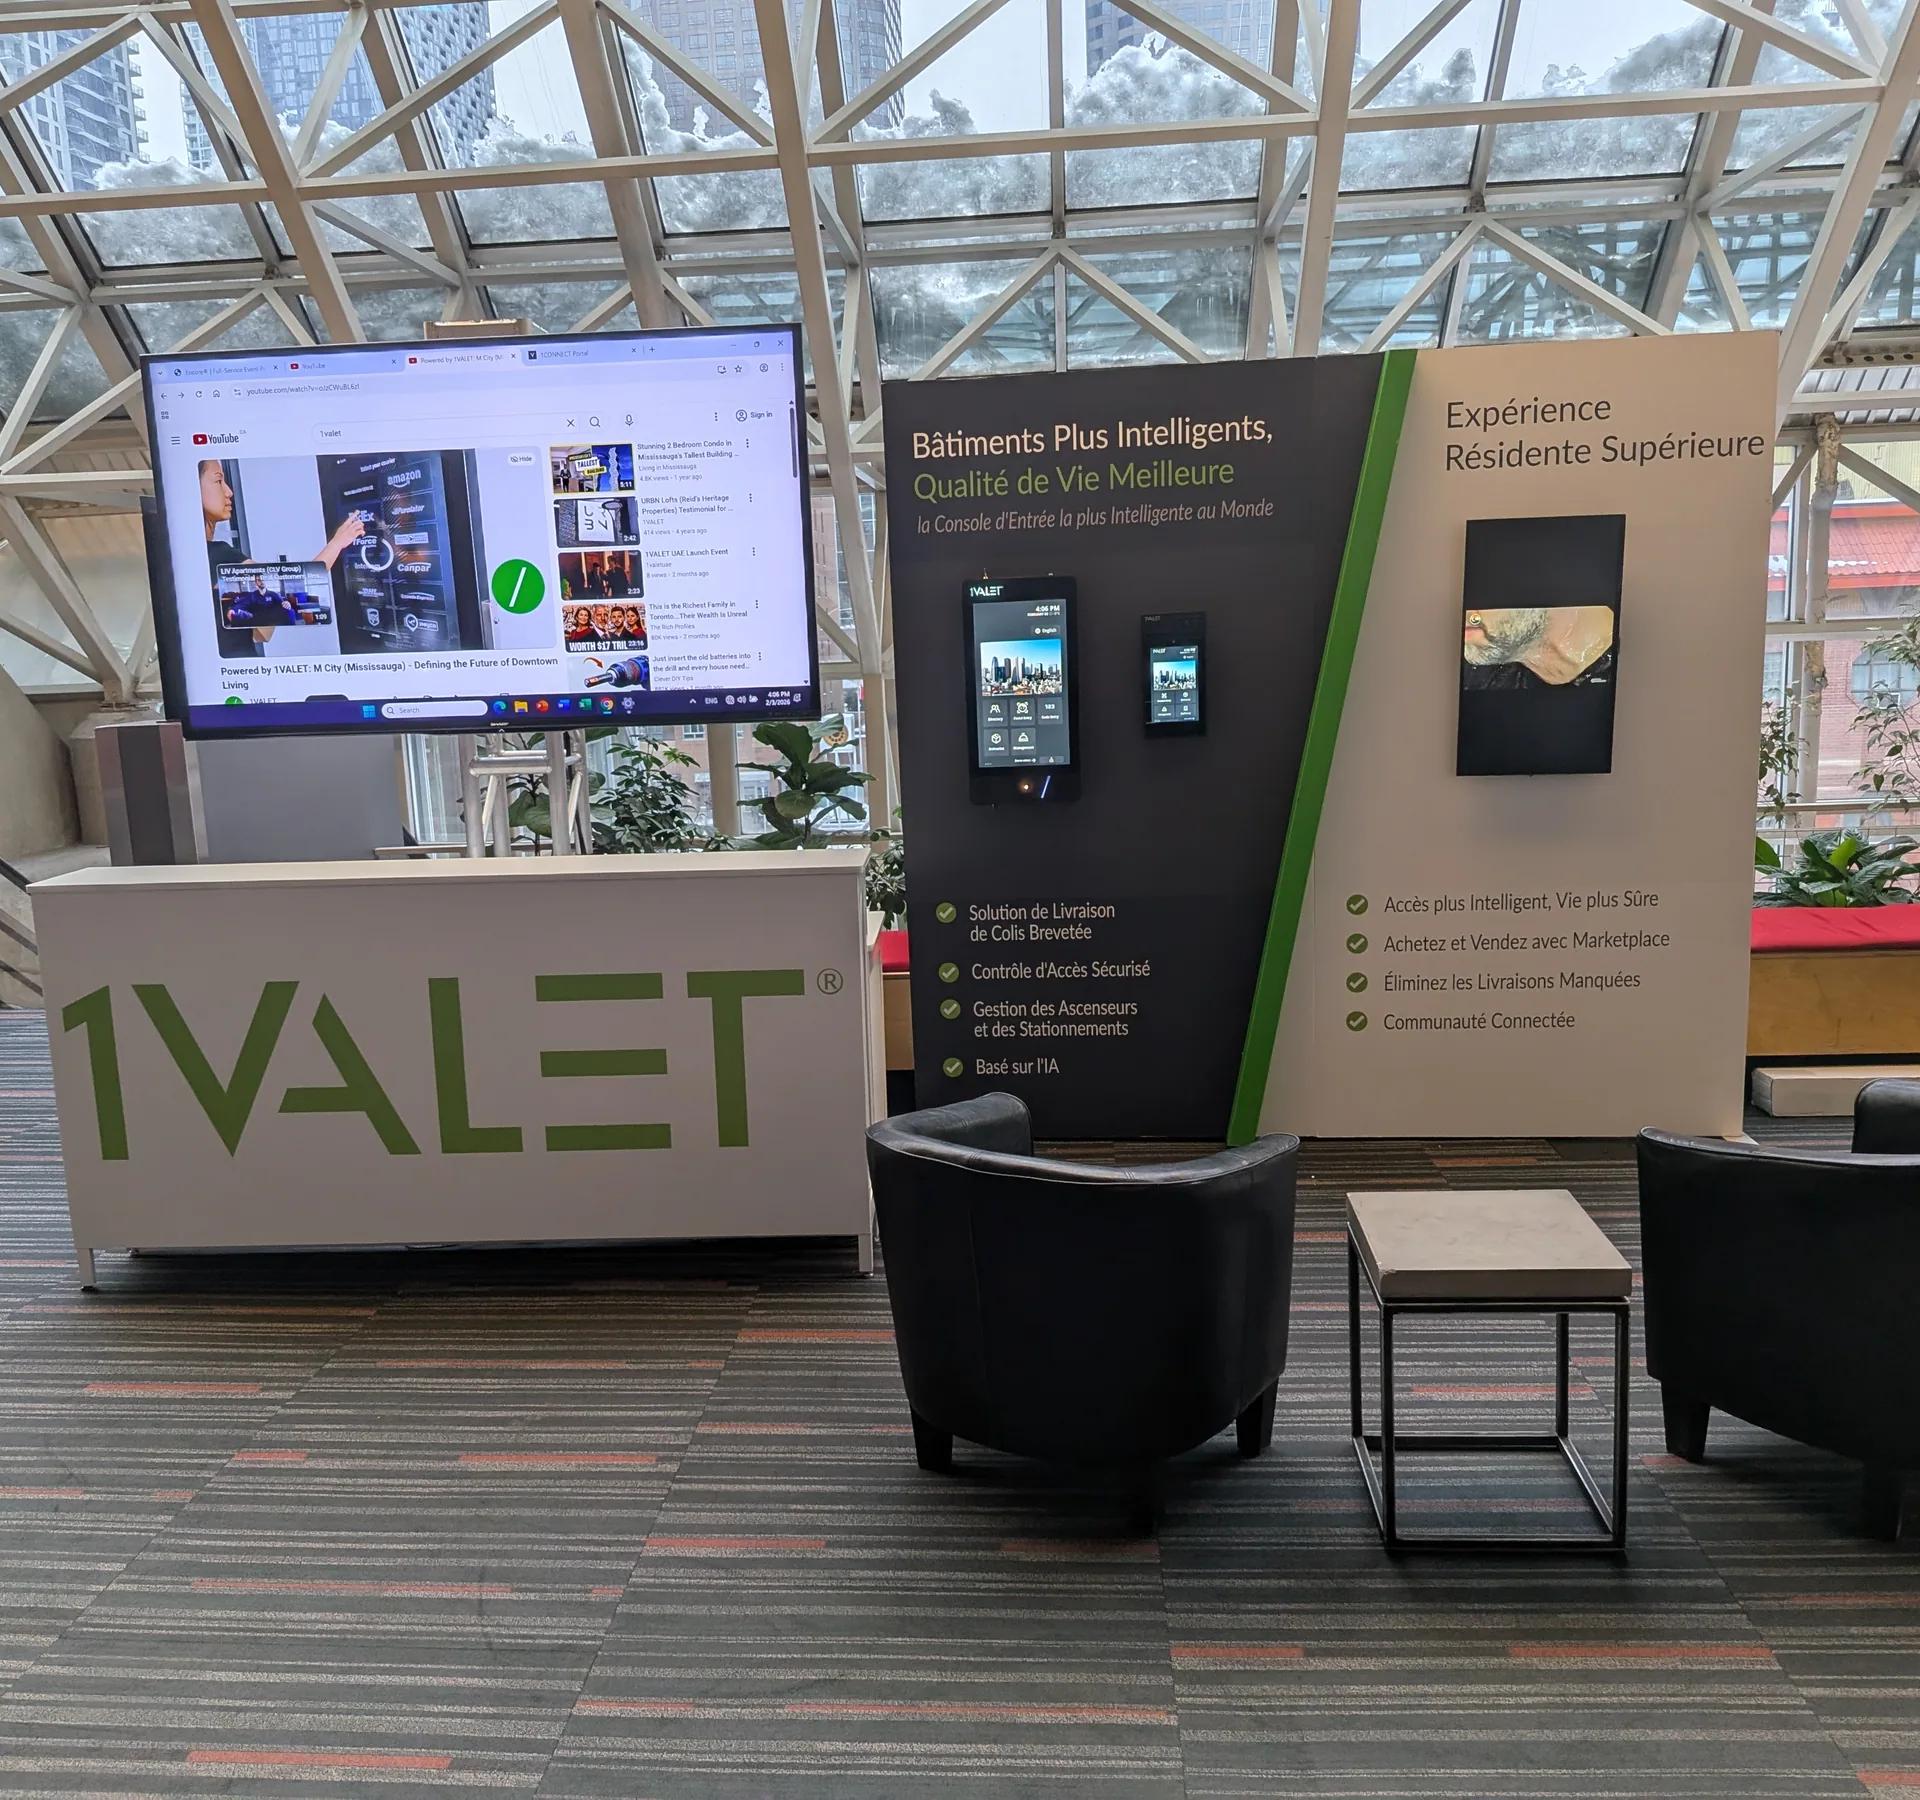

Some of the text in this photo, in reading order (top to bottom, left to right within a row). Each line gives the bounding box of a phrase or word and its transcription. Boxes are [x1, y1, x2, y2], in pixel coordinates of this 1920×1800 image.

[750, 410, 773, 420] Sign in
[1446, 396, 1612, 432] Expérience
[208, 433, 239, 445] YouTube
[320, 430, 341, 438] 1valet
[912, 415, 1274, 459] Bâtiments Plus Intelligents,
[637, 440, 724, 451] Stunning Bedroom Condo
[1446, 431, 1765, 472] Résidente Supérieure
[638, 452, 682, 461] Mississauga's
[706, 450, 733, 460] Building
[577, 459, 598, 467] TALLEST
[639, 463, 696, 472] Living Mississauga
[387, 469, 421, 486] amazon
[913, 459, 1235, 503] Qualité de Vie Meilleure
[661, 496, 678, 504] Lofts
[679, 495, 701, 504] (Reid's
[702, 494, 729, 503] Heritage
[641, 504, 726, 515] Properties) Testimonial for
[918, 498, 1274, 534] la Console d'Entrée la plus Intelligente au Monde
[646, 550, 670, 558] 1VALET
[671, 549, 685, 557] UAE
[397, 562, 431, 573] Canpar
[970, 586, 1004, 597] 1VALET
[683, 601, 706, 609] Richest
[707, 601, 726, 609] Family
[727, 610, 748, 618] Unreal
[569, 642, 596, 652] WORTH
[597, 641, 610, 651] $17
[666, 654, 686, 662] insert
[739, 652, 751, 660] into
[220, 657, 558, 676] Powered by 1VALET: M City (Mississauga) Defining the Future of Downtown
[665, 664, 676, 672] drill
[677, 663, 690, 671] and
[691, 664, 707, 672] every
[222, 681, 249, 690] Living
[1384, 890, 1659, 915] Accès plus Intelligent, Vie plus Sûre
[969, 902, 1115, 921] Solution de Livraison
[970, 923, 1092, 942] de Colis Brevetée
[1384, 930, 1671, 952] Achetez et Vendez avec Marketplace
[972, 960, 1151, 980] Contrôle d'Accès Sécurisé
[1384, 970, 1641, 992] Éliminez les Livraisons Manquées
[973, 1000, 1138, 1018] Gestion des Ascenseurs
[1384, 1011, 1576, 1031] Communauté Connectée
[974, 1020, 1129, 1037] et des Stationnements
[976, 1058, 1060, 1075] Basé sur l'IA
